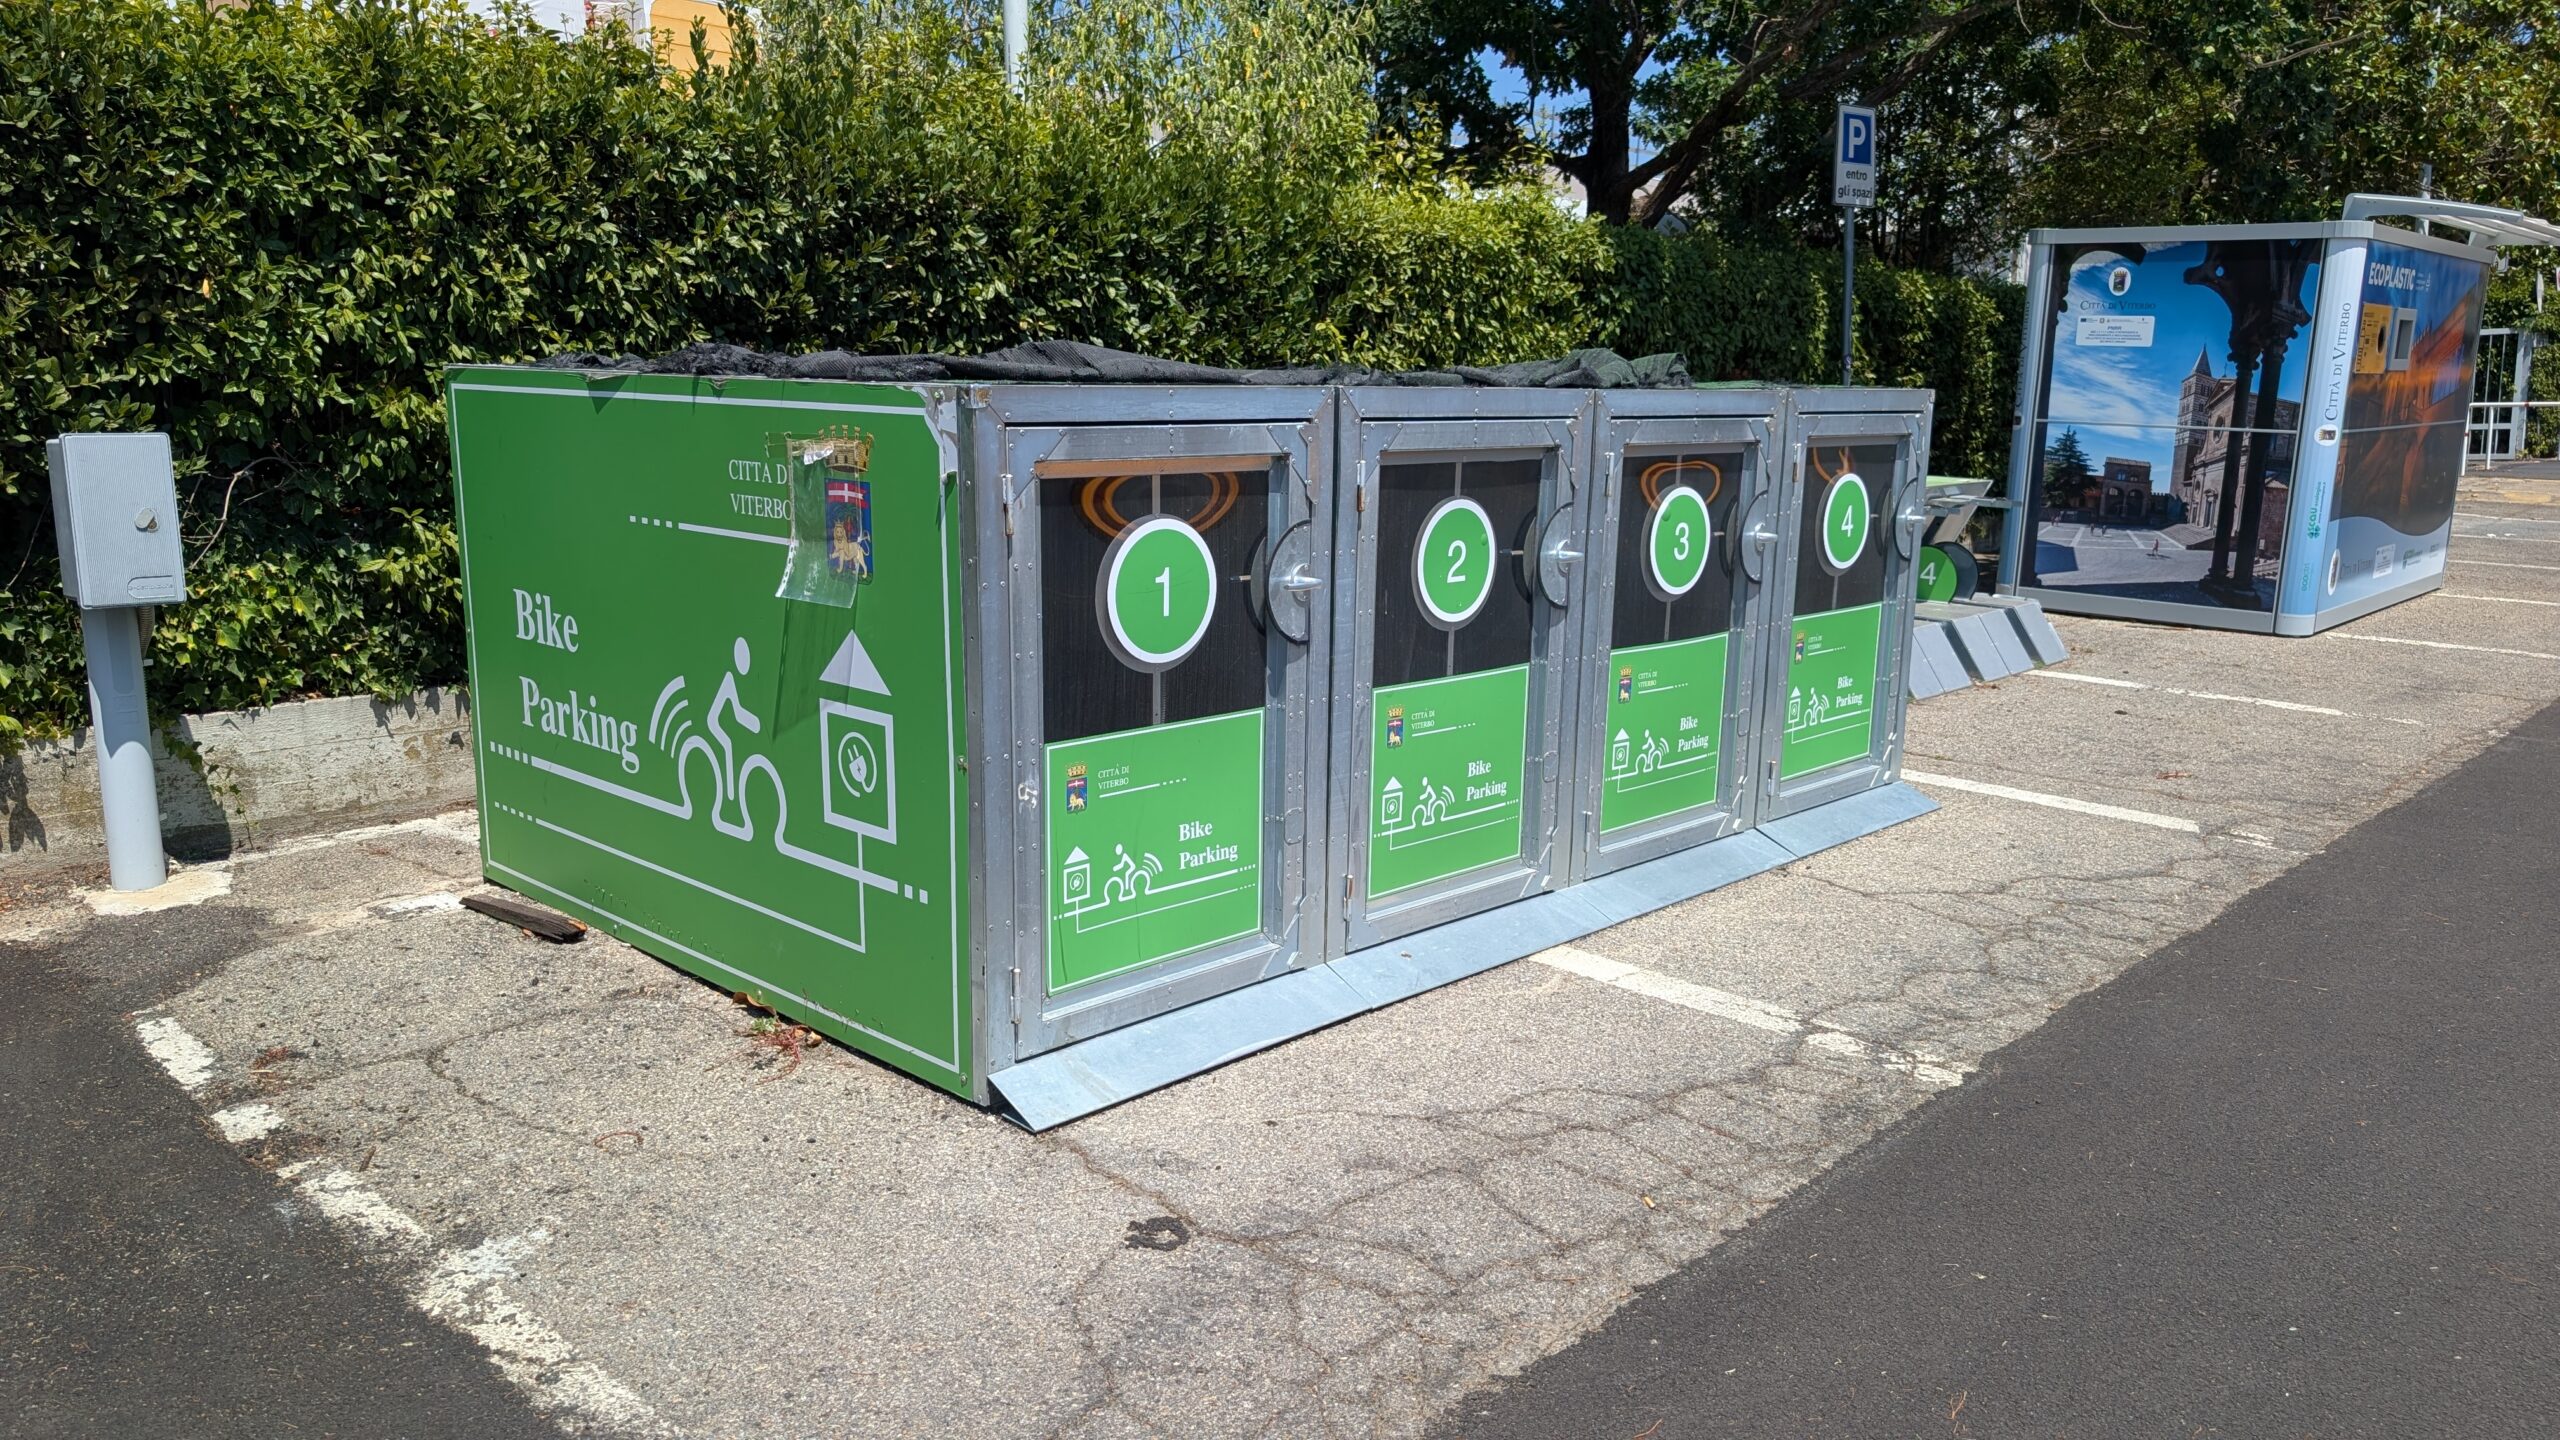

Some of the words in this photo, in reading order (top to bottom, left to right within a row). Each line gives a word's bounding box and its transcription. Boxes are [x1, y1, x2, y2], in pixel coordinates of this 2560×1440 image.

[1848, 118, 1866, 159] P
[1846, 169, 1868, 181] entro
[1838, 185, 1850, 198] gli
[1852, 187, 1873, 199] spazi
[2368, 262, 2416, 291] ECOPLASTIC
[2332, 302, 2352, 361] VITERBO
[775, 463, 788, 485] D
[729, 493, 792, 521] VITERBO
[1841, 505, 1853, 538] 4
[1673, 521, 1690, 561] 3
[1446, 540, 1467, 584] 2
[1919, 561, 1937, 586] 4
[1154, 566, 1170, 617] 1
[512, 588, 580, 653] Bike
[1837, 675, 1854, 689] Bike
[1835, 693, 1863, 708] Parking
[518, 675, 640, 774] Parking
[1680, 716, 1698, 731] Bike
[1677, 734, 1709, 753] Parking
[1467, 760, 1491, 778] Bike
[1098, 777, 1129, 789] VITERBO
[1465, 780, 1507, 801] Parking
[1178, 820, 1213, 842] Bike
[1178, 844, 1239, 870] Parking
